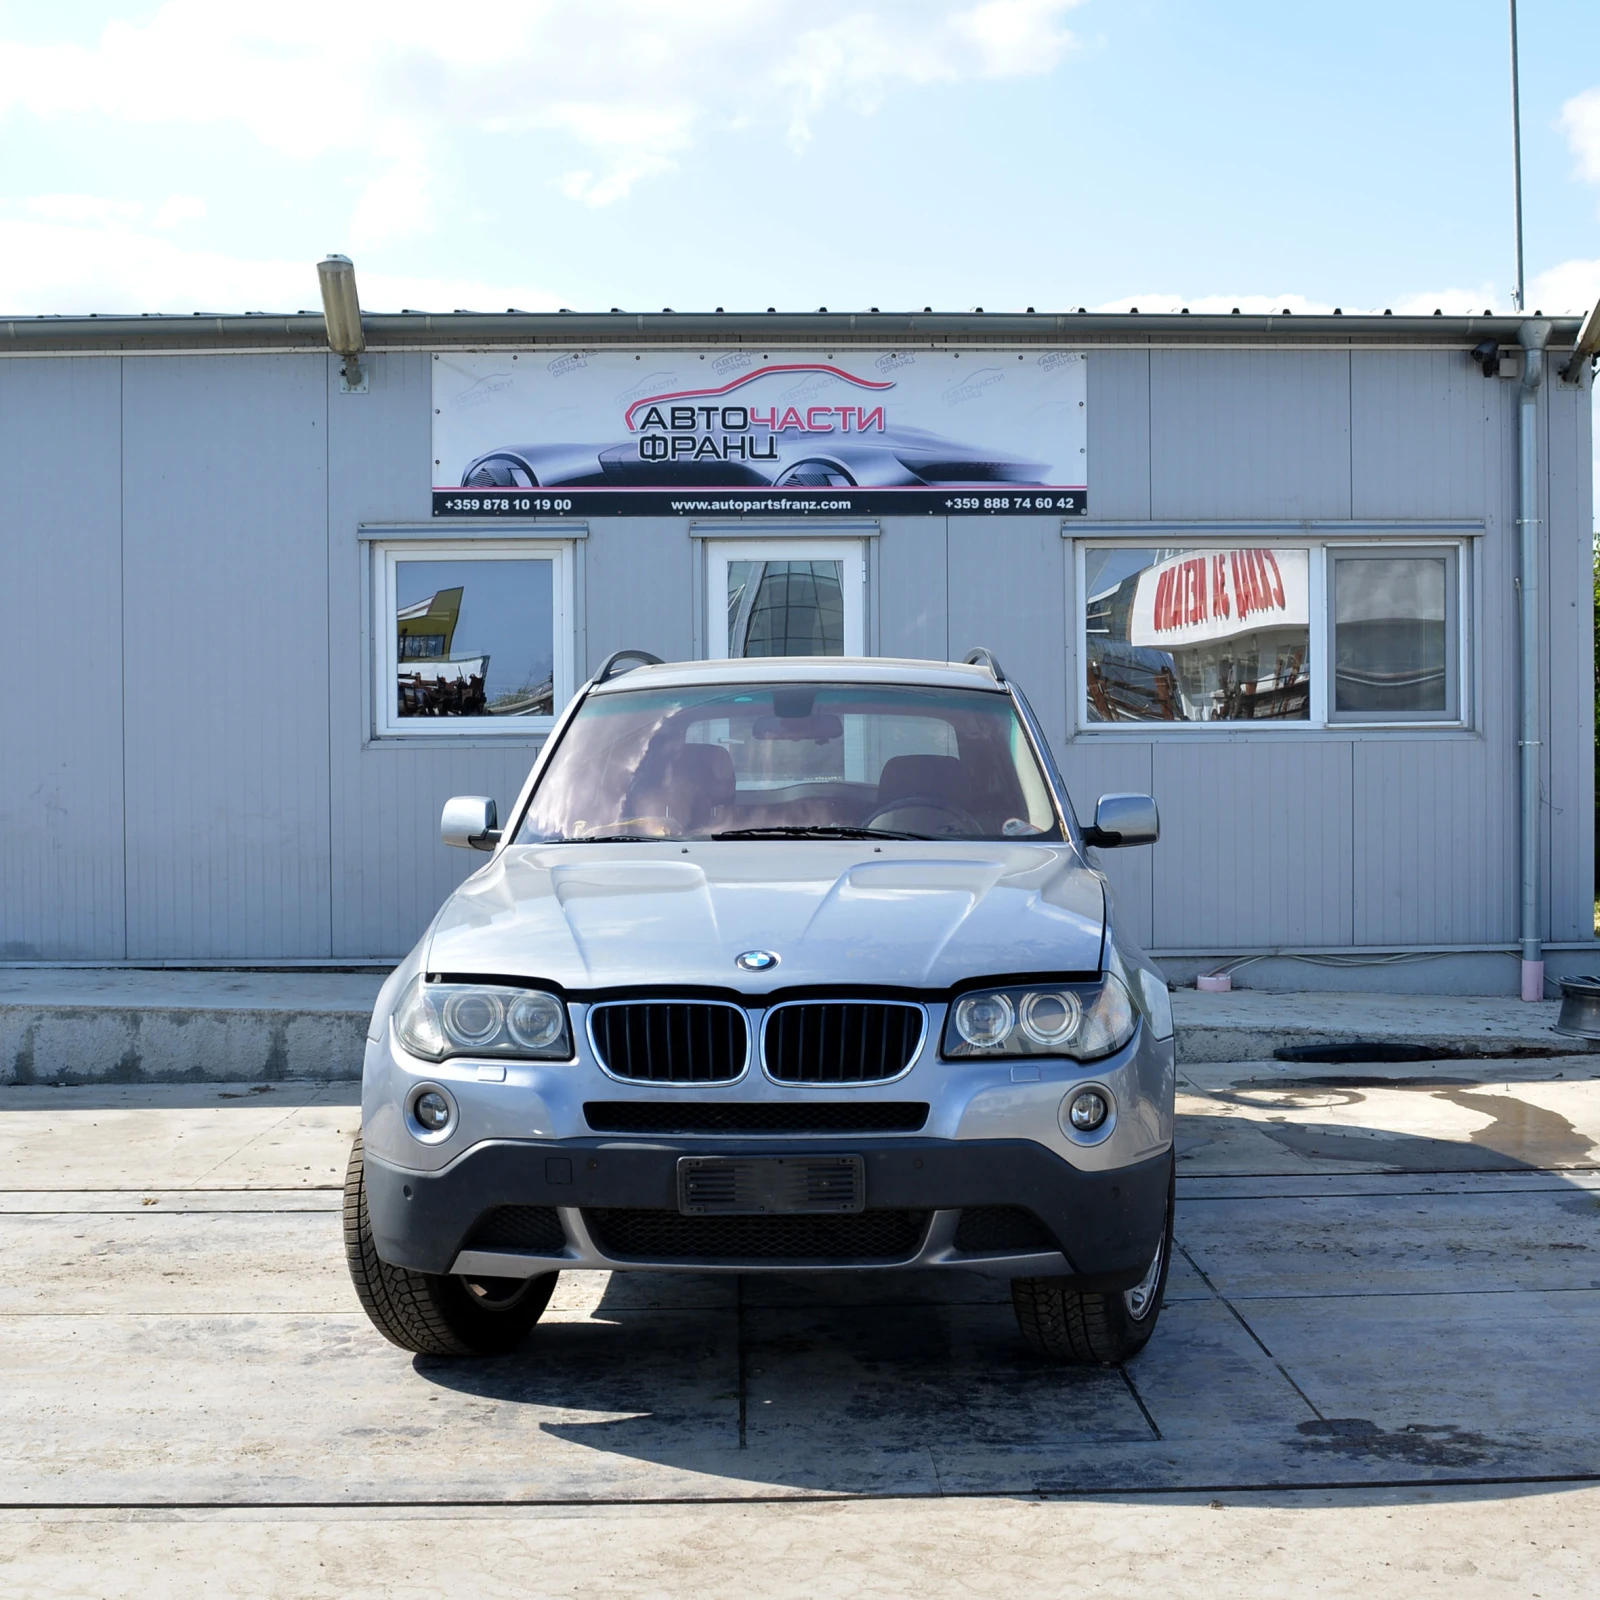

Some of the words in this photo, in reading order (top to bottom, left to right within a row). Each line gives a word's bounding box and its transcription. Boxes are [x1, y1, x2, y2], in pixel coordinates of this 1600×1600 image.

[552, 360, 588, 378] ФРАНЦ
[717, 359, 752, 376] ФРАНЦ
[881, 356, 916, 374] ФРАНЦ
[640, 406, 884, 431] АВТОЧАСТИ
[639, 434, 779, 462] ФРАНЦ
[445, 499, 480, 510] +359
[483, 499, 509, 510] 878
[513, 499, 530, 510] 10
[534, 499, 551, 510] 19
[554, 499, 571, 510] 00
[671, 499, 851, 512] www.autopartsfranz.com
[945, 498, 980, 509] +359
[983, 498, 1010, 509] 888
[1013, 498, 1032, 509] 74
[1035, 498, 1053, 509] 60
[1056, 498, 1074, 509] 42
